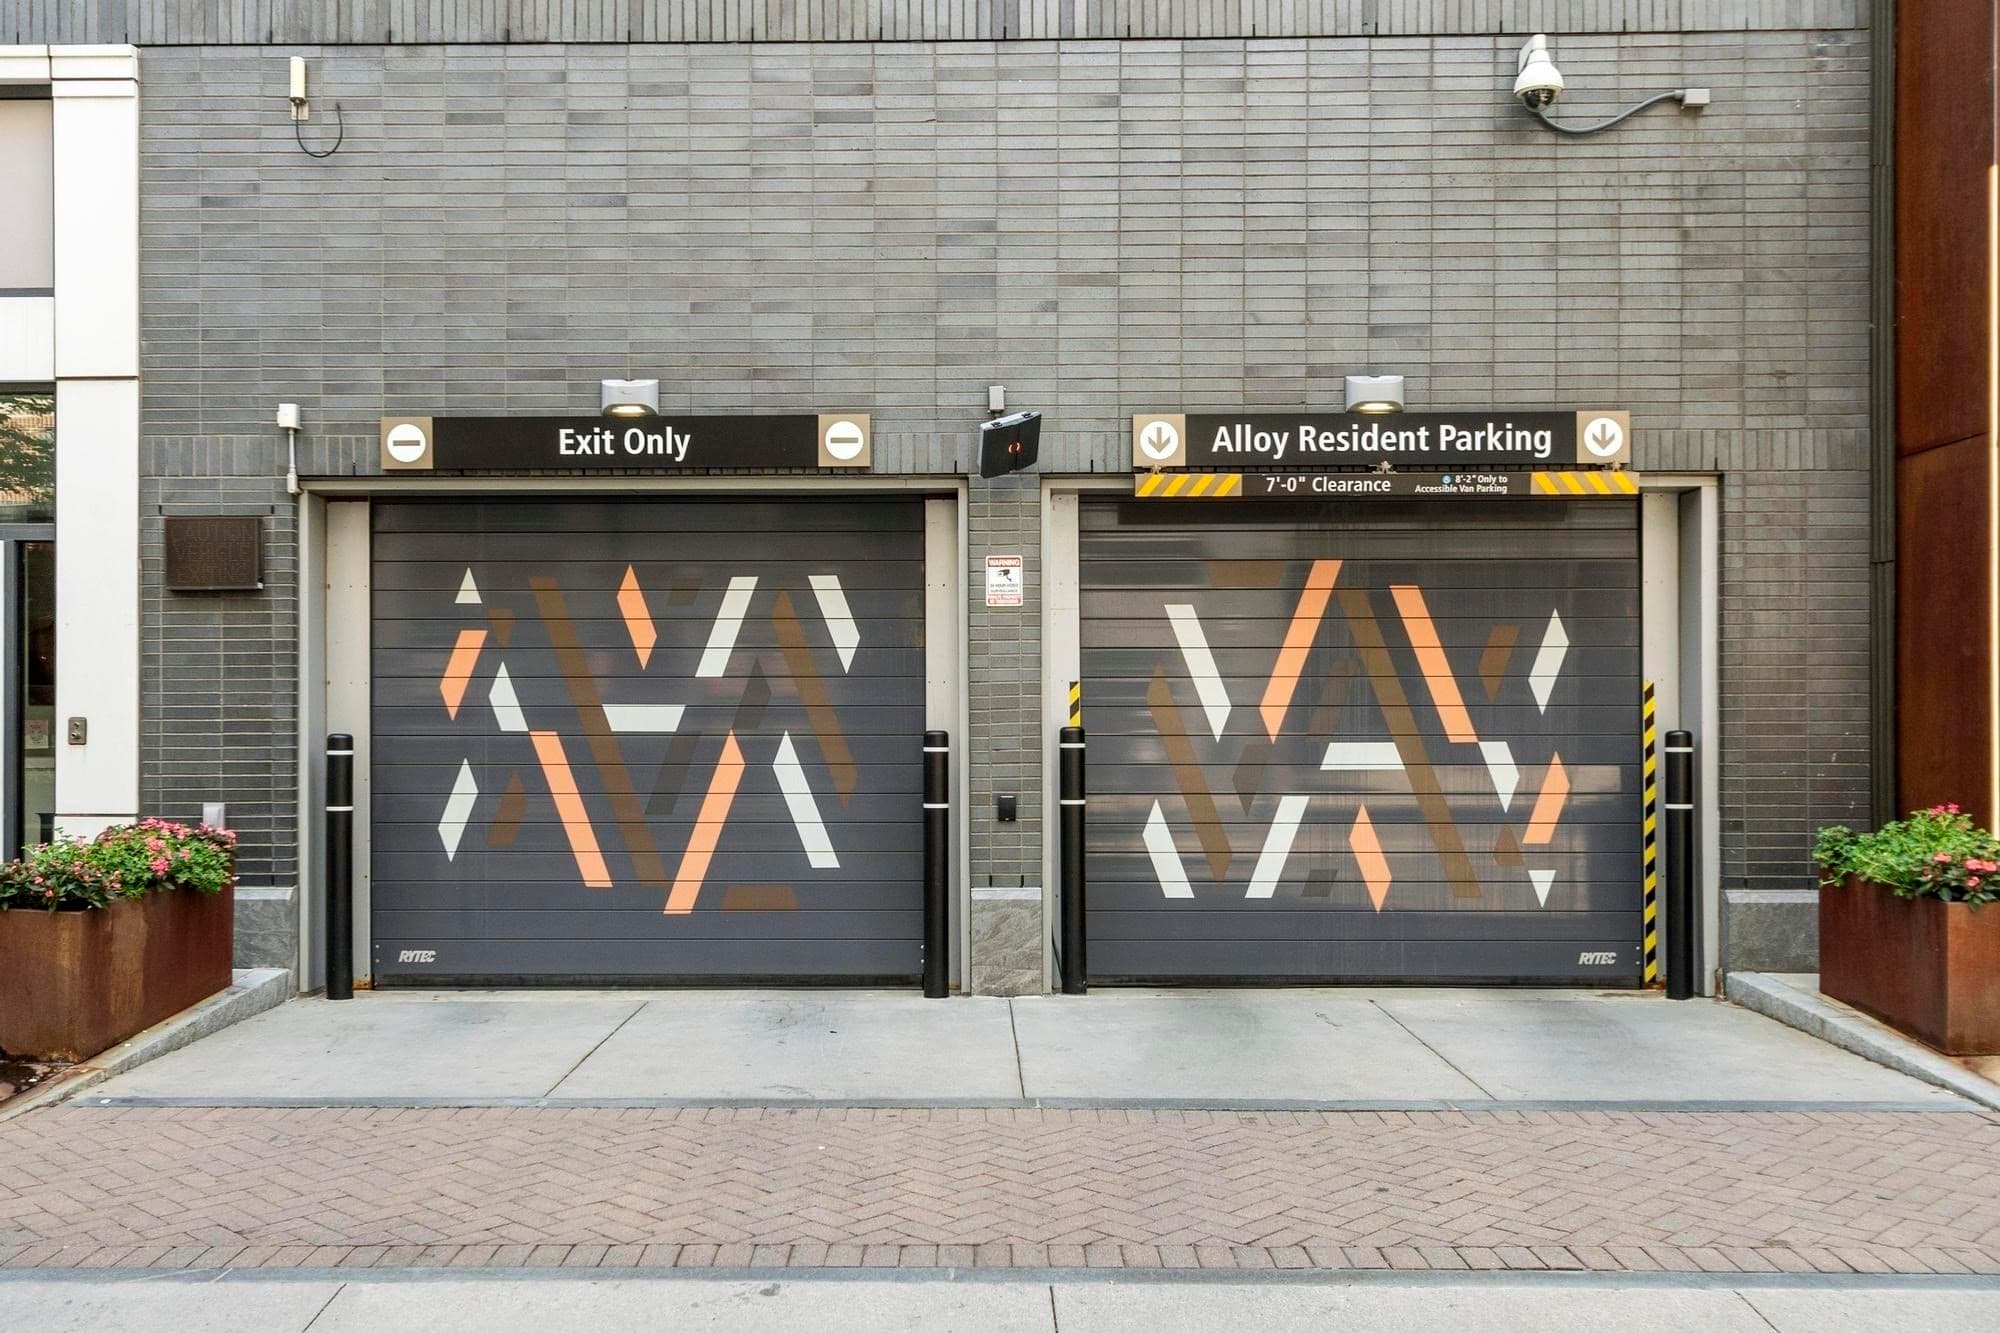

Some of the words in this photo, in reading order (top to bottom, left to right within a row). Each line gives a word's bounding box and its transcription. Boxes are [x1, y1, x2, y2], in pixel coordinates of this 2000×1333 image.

[559, 427, 615, 455] Exit
[624, 426, 691, 462] Only
[1211, 424, 1289, 459] Alloy
[1299, 424, 1430, 452] Resident
[1439, 423, 1552, 458] Parking
[1266, 476, 1306, 492] 7'-0"
[1312, 476, 1392, 492] Clearance
[1478, 475, 1497, 485] Only
[1499, 475, 1508, 484] to
[1415, 484, 1458, 493] Accessible
[1459, 485, 1474, 493] Van
[1476, 484, 1508, 495] Parking
[398, 950, 437, 962] RYTEC
[1578, 952, 1617, 965] RYTEC
